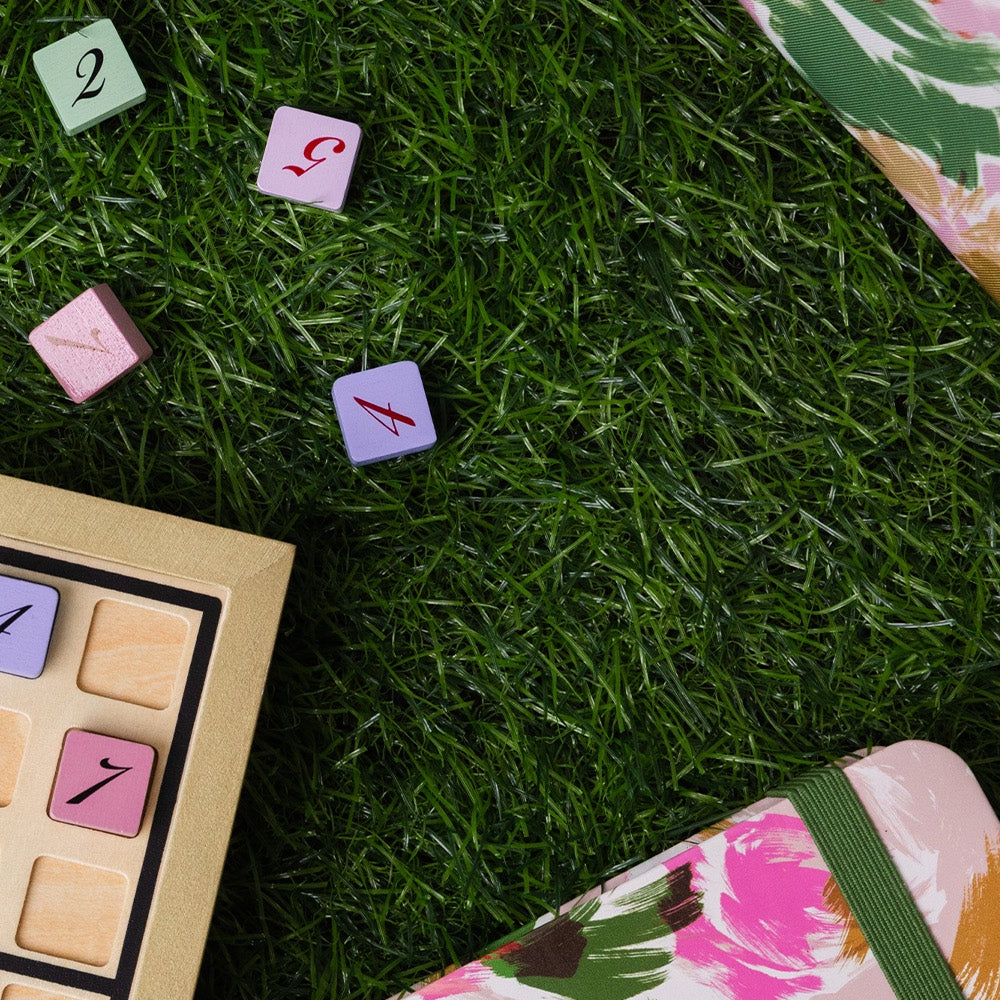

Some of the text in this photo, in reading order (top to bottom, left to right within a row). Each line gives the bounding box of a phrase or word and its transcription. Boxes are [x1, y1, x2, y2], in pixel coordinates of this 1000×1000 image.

[72, 48, 105, 108] 2
[282, 137, 346, 177] 5
[353, 396, 416, 437] 4
[65, 758, 133, 804] 7
